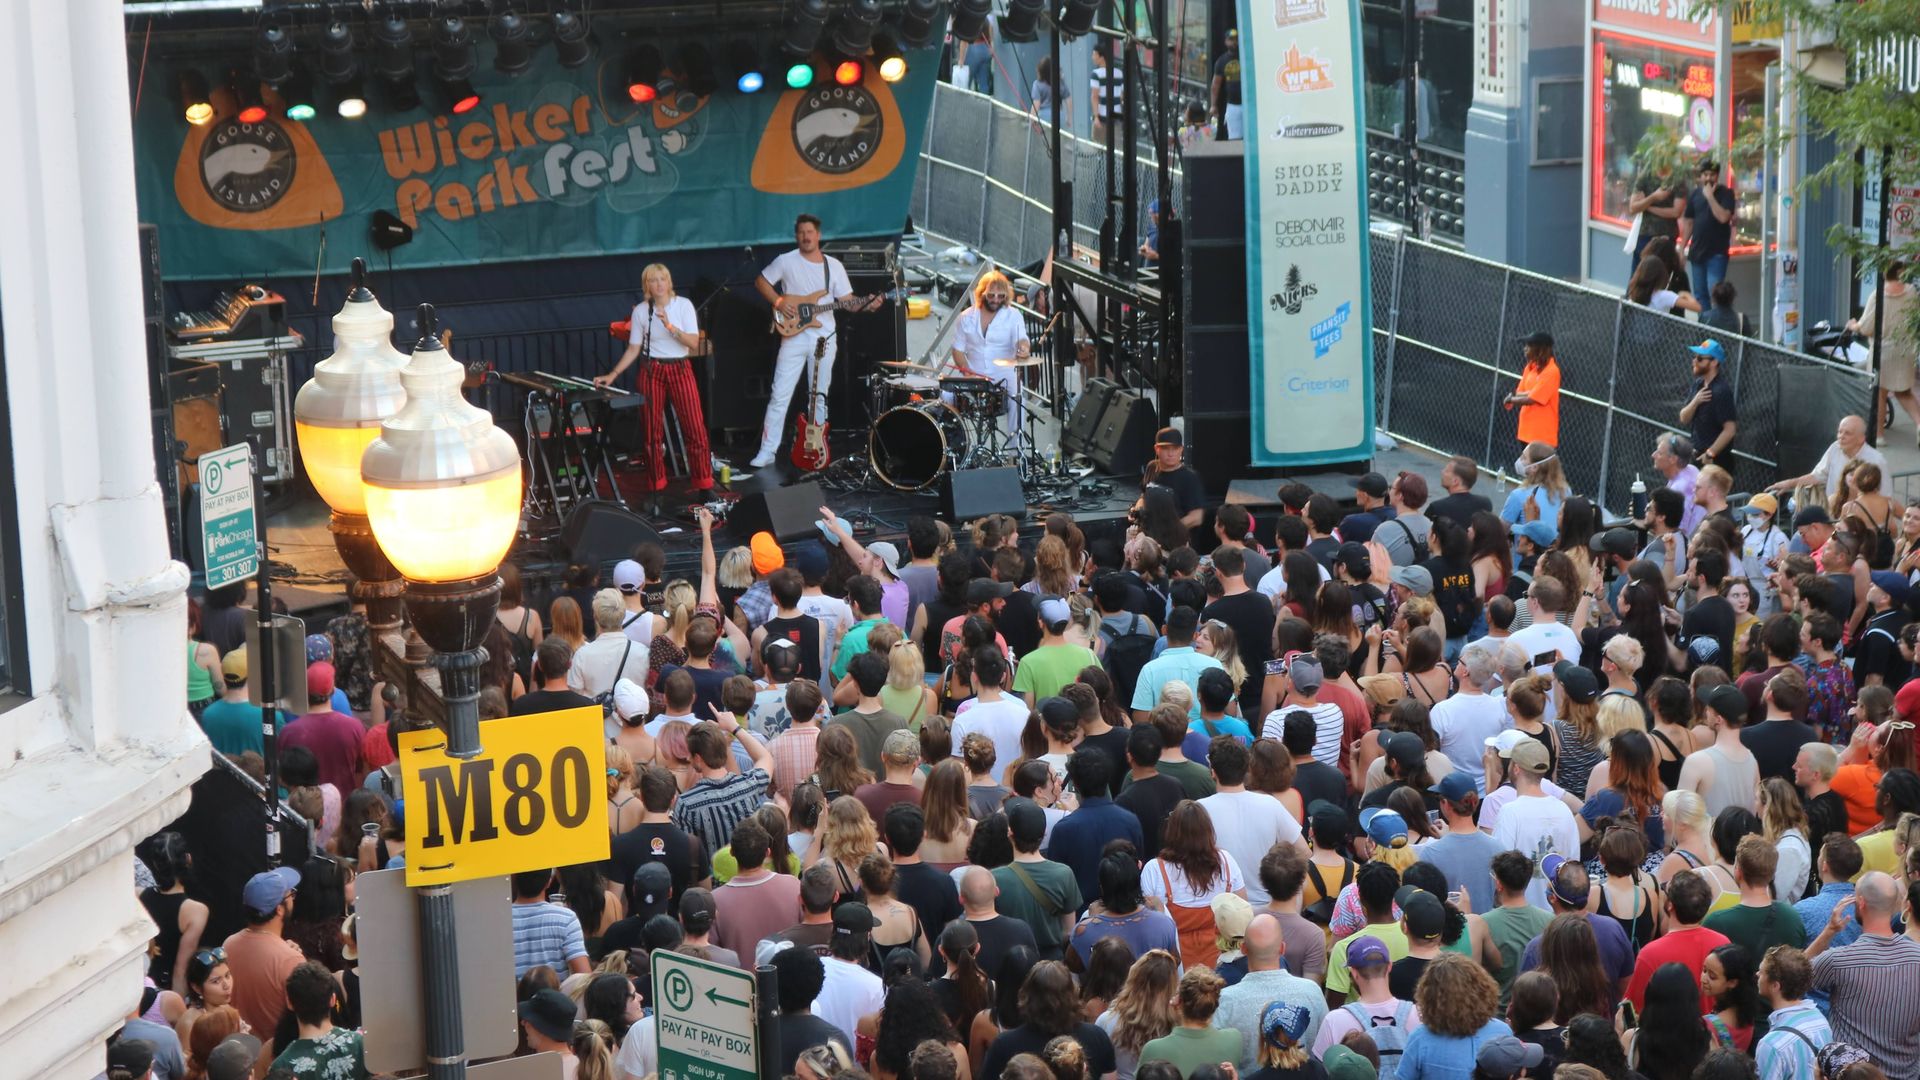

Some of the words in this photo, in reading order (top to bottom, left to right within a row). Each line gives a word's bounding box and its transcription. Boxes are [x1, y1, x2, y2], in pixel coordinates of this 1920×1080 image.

[810, 87, 865, 108] GOOSE
[216, 124, 276, 144] GOOSE
[378, 94, 591, 180] Wicker
[1270, 114, 1340, 140] Subterranean
[809, 141, 868, 166] ISLAND
[1274, 162, 1343, 180] SMOKE
[218, 178, 280, 205] ISLAND
[395, 156, 539, 230] Park
[1275, 178, 1343, 197] DADDY
[1275, 216, 1345, 235] DEBONAIR
[1275, 233, 1315, 248] SOCIAL
[1316, 232, 1346, 246] CLUB
[1311, 311, 1347, 338] TRANSIT
[1318, 328, 1341, 349] TEES
[1287, 376, 1350, 392] Criterion
[210, 467, 219, 488] P
[205, 500, 216, 511] PAY
[217, 497, 224, 508] AT
[225, 494, 236, 505] PAY
[237, 490, 250, 501] BOX
[222, 566, 236, 581] 301
[238, 559, 252, 575] 307
[418, 746, 591, 849] M80
[672, 976, 687, 1002] P
[661, 1019, 682, 1036] PAY
[684, 1026, 698, 1041] AT
[701, 1031, 722, 1048] PAY
[725, 1037, 752, 1056] BOX
[700, 1049, 711, 1057] OR
[687, 1064, 704, 1076] SIGN
[705, 1069, 716, 1079] UP
